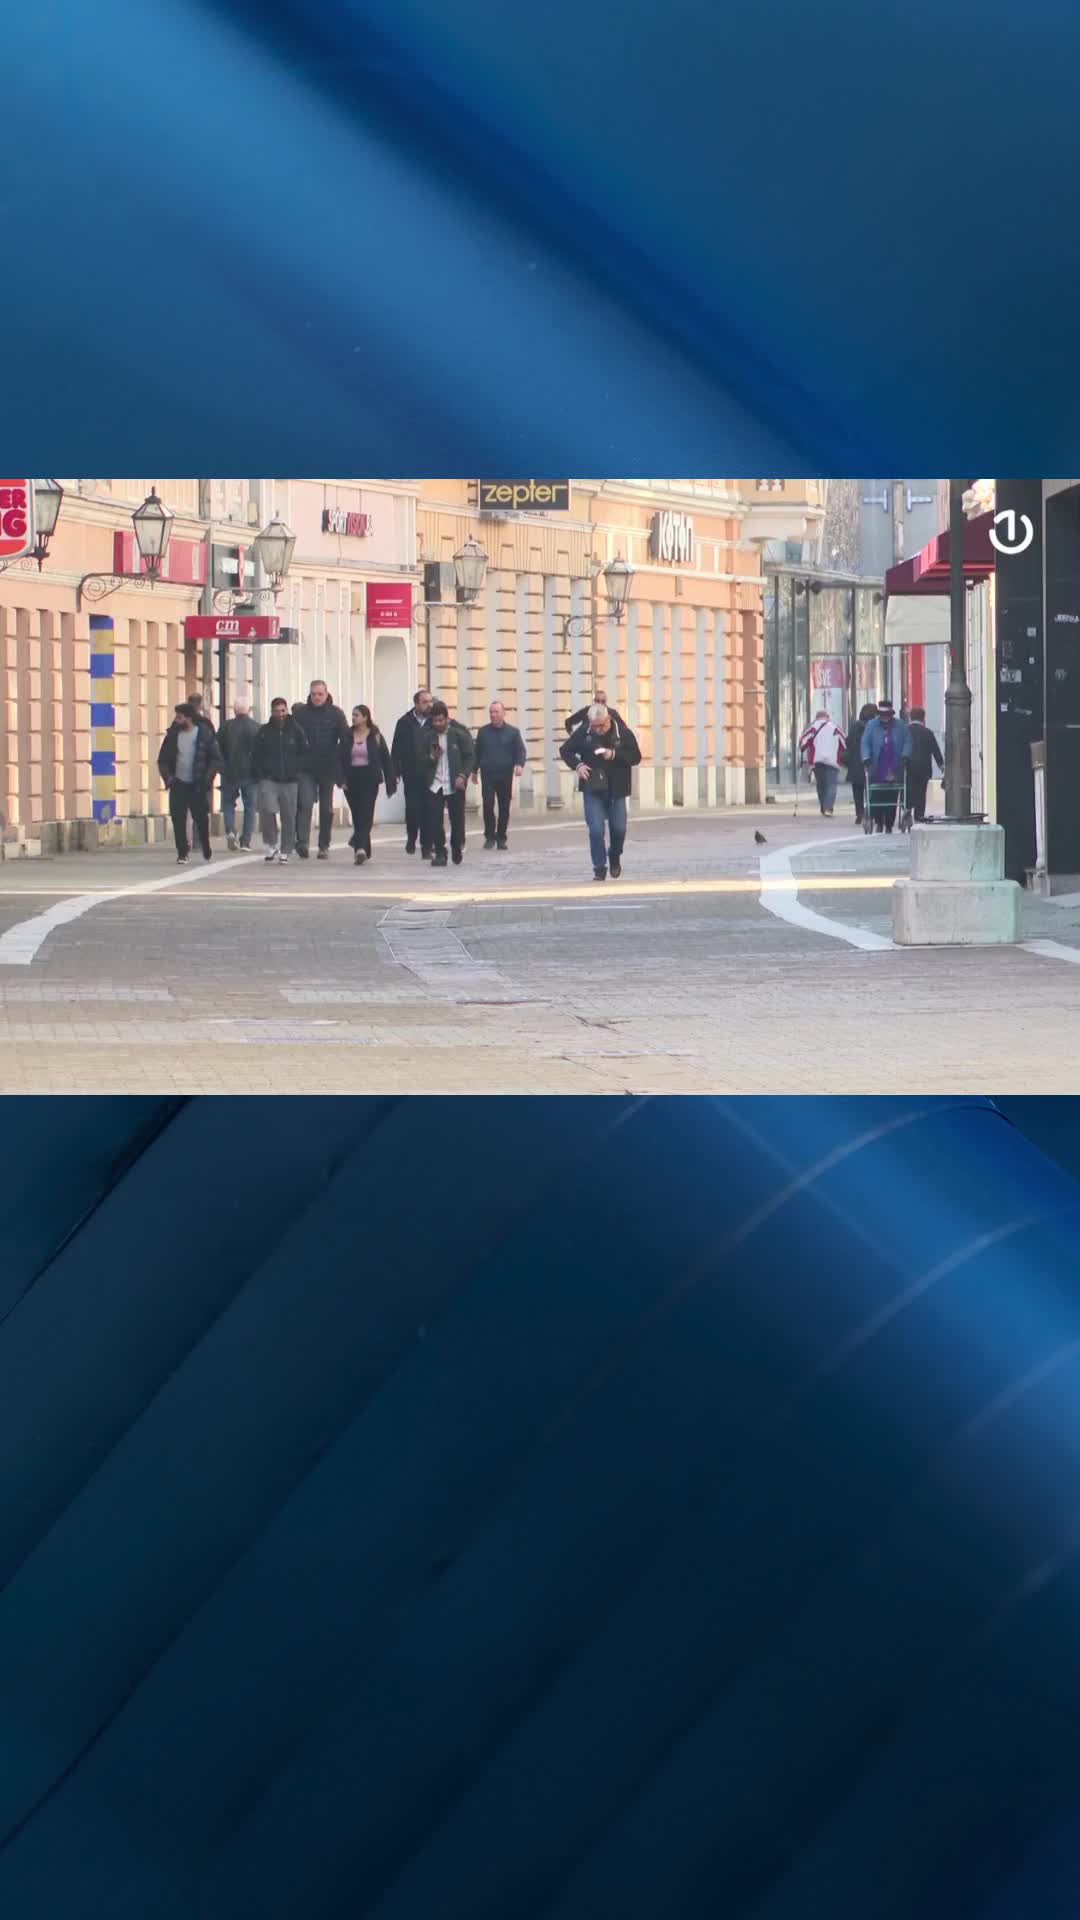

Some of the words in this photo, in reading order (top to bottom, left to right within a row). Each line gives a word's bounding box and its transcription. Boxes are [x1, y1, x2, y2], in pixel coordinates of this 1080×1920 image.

[482, 480, 567, 509] zepter
[0, 509, 27, 537] G
[215, 619, 240, 631] cm
